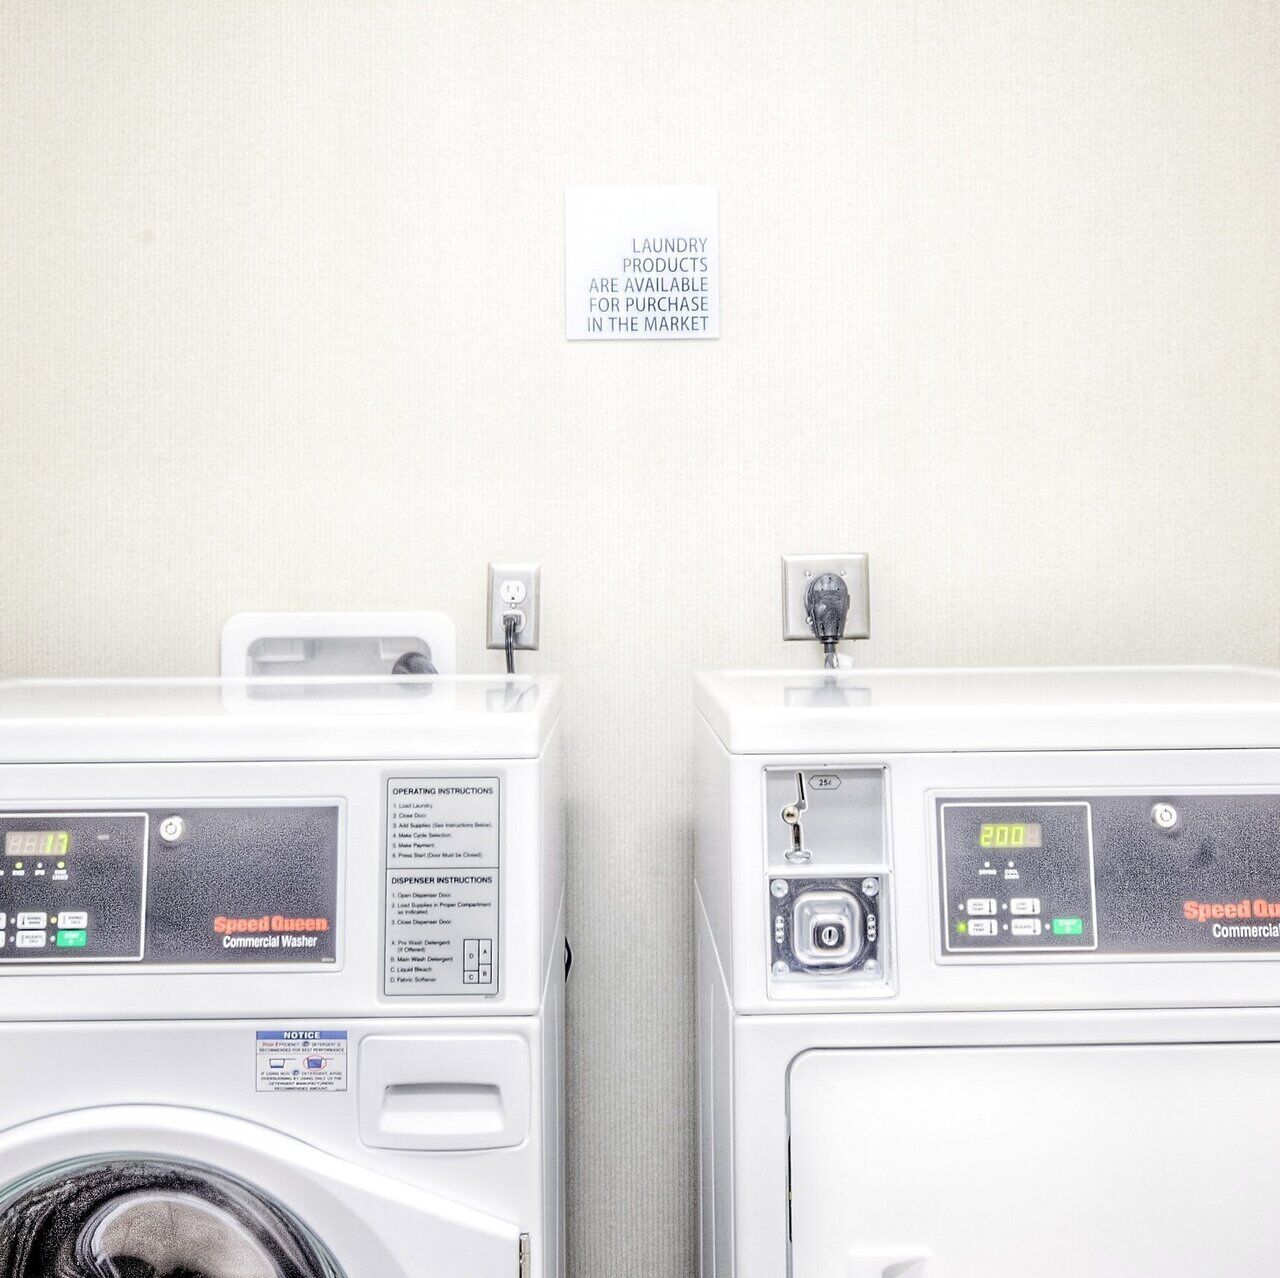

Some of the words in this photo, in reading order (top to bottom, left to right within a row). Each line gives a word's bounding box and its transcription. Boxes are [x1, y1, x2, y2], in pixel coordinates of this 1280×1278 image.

[632, 237, 708, 253] LAUNDRY
[623, 257, 708, 273] PRODUCTS
[589, 277, 619, 293] ARE
[624, 277, 709, 292] AVAILABLE
[589, 297, 620, 312] FOR
[626, 296, 709, 312] PURCHASE
[587, 317, 603, 332] IN
[608, 317, 638, 332] THE
[644, 316, 709, 331] MARKET
[980, 826, 1024, 846] 200
[391, 877, 435, 885] DISPENSER
[1184, 900, 1252, 922] Speed
[214, 915, 270, 934] Speed
[271, 915, 329, 932] Queen
[222, 935, 279, 948] Commercial
[281, 935, 318, 948] Washer
[283, 1031, 321, 1039] NOTICE
